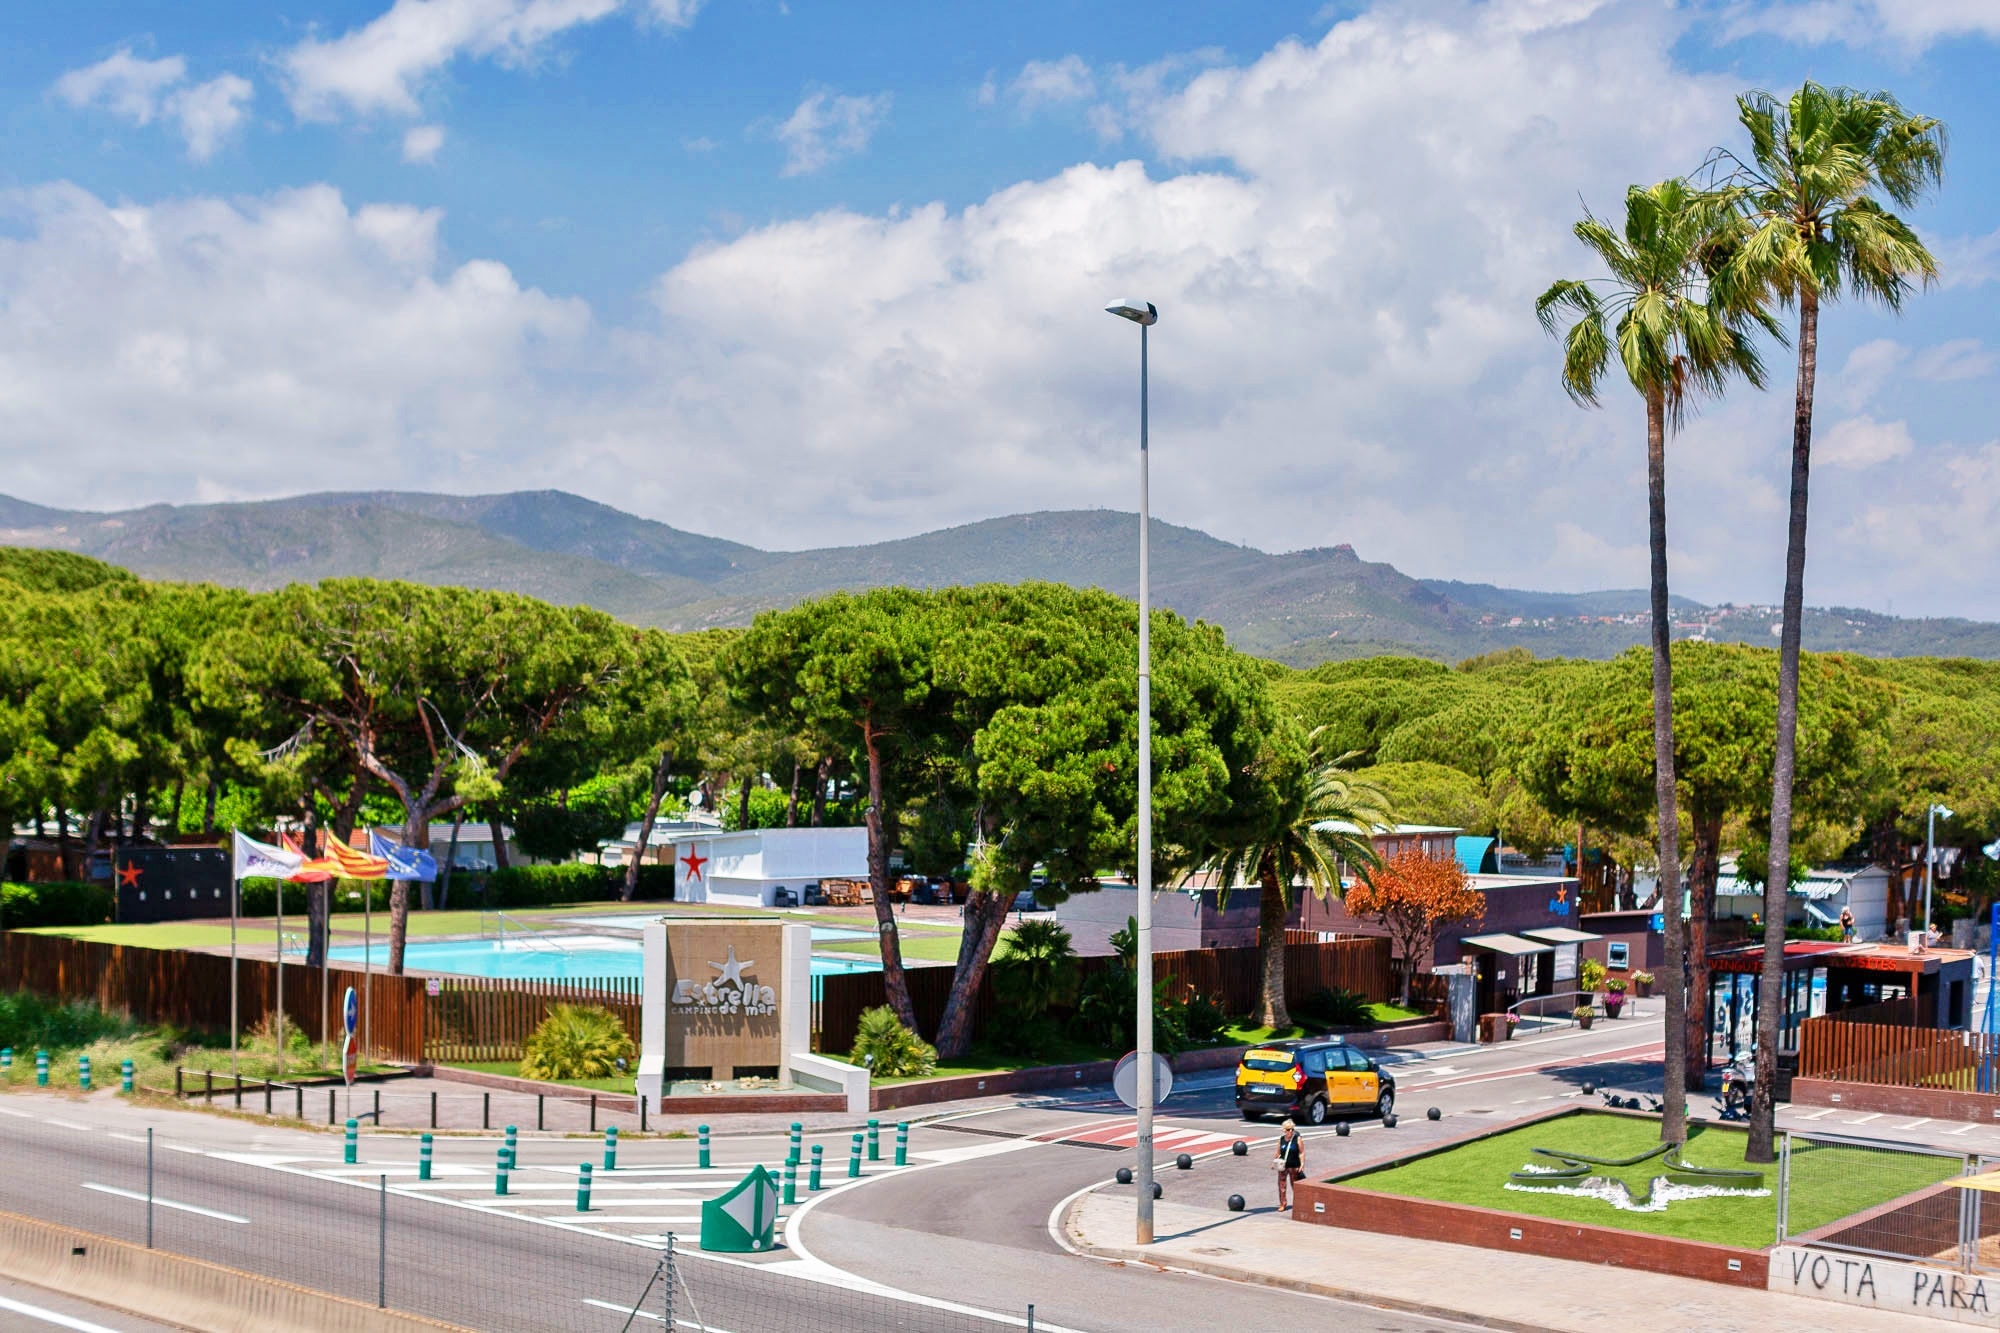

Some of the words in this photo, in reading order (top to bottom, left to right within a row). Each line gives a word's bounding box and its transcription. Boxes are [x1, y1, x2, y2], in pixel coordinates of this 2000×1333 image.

[671, 979, 776, 1006] Estrella
[719, 1001, 738, 1015] de
[744, 1003, 777, 1017] mar
[1792, 1251, 1876, 1300] VOTA
[1912, 1271, 1989, 1312] PARA
